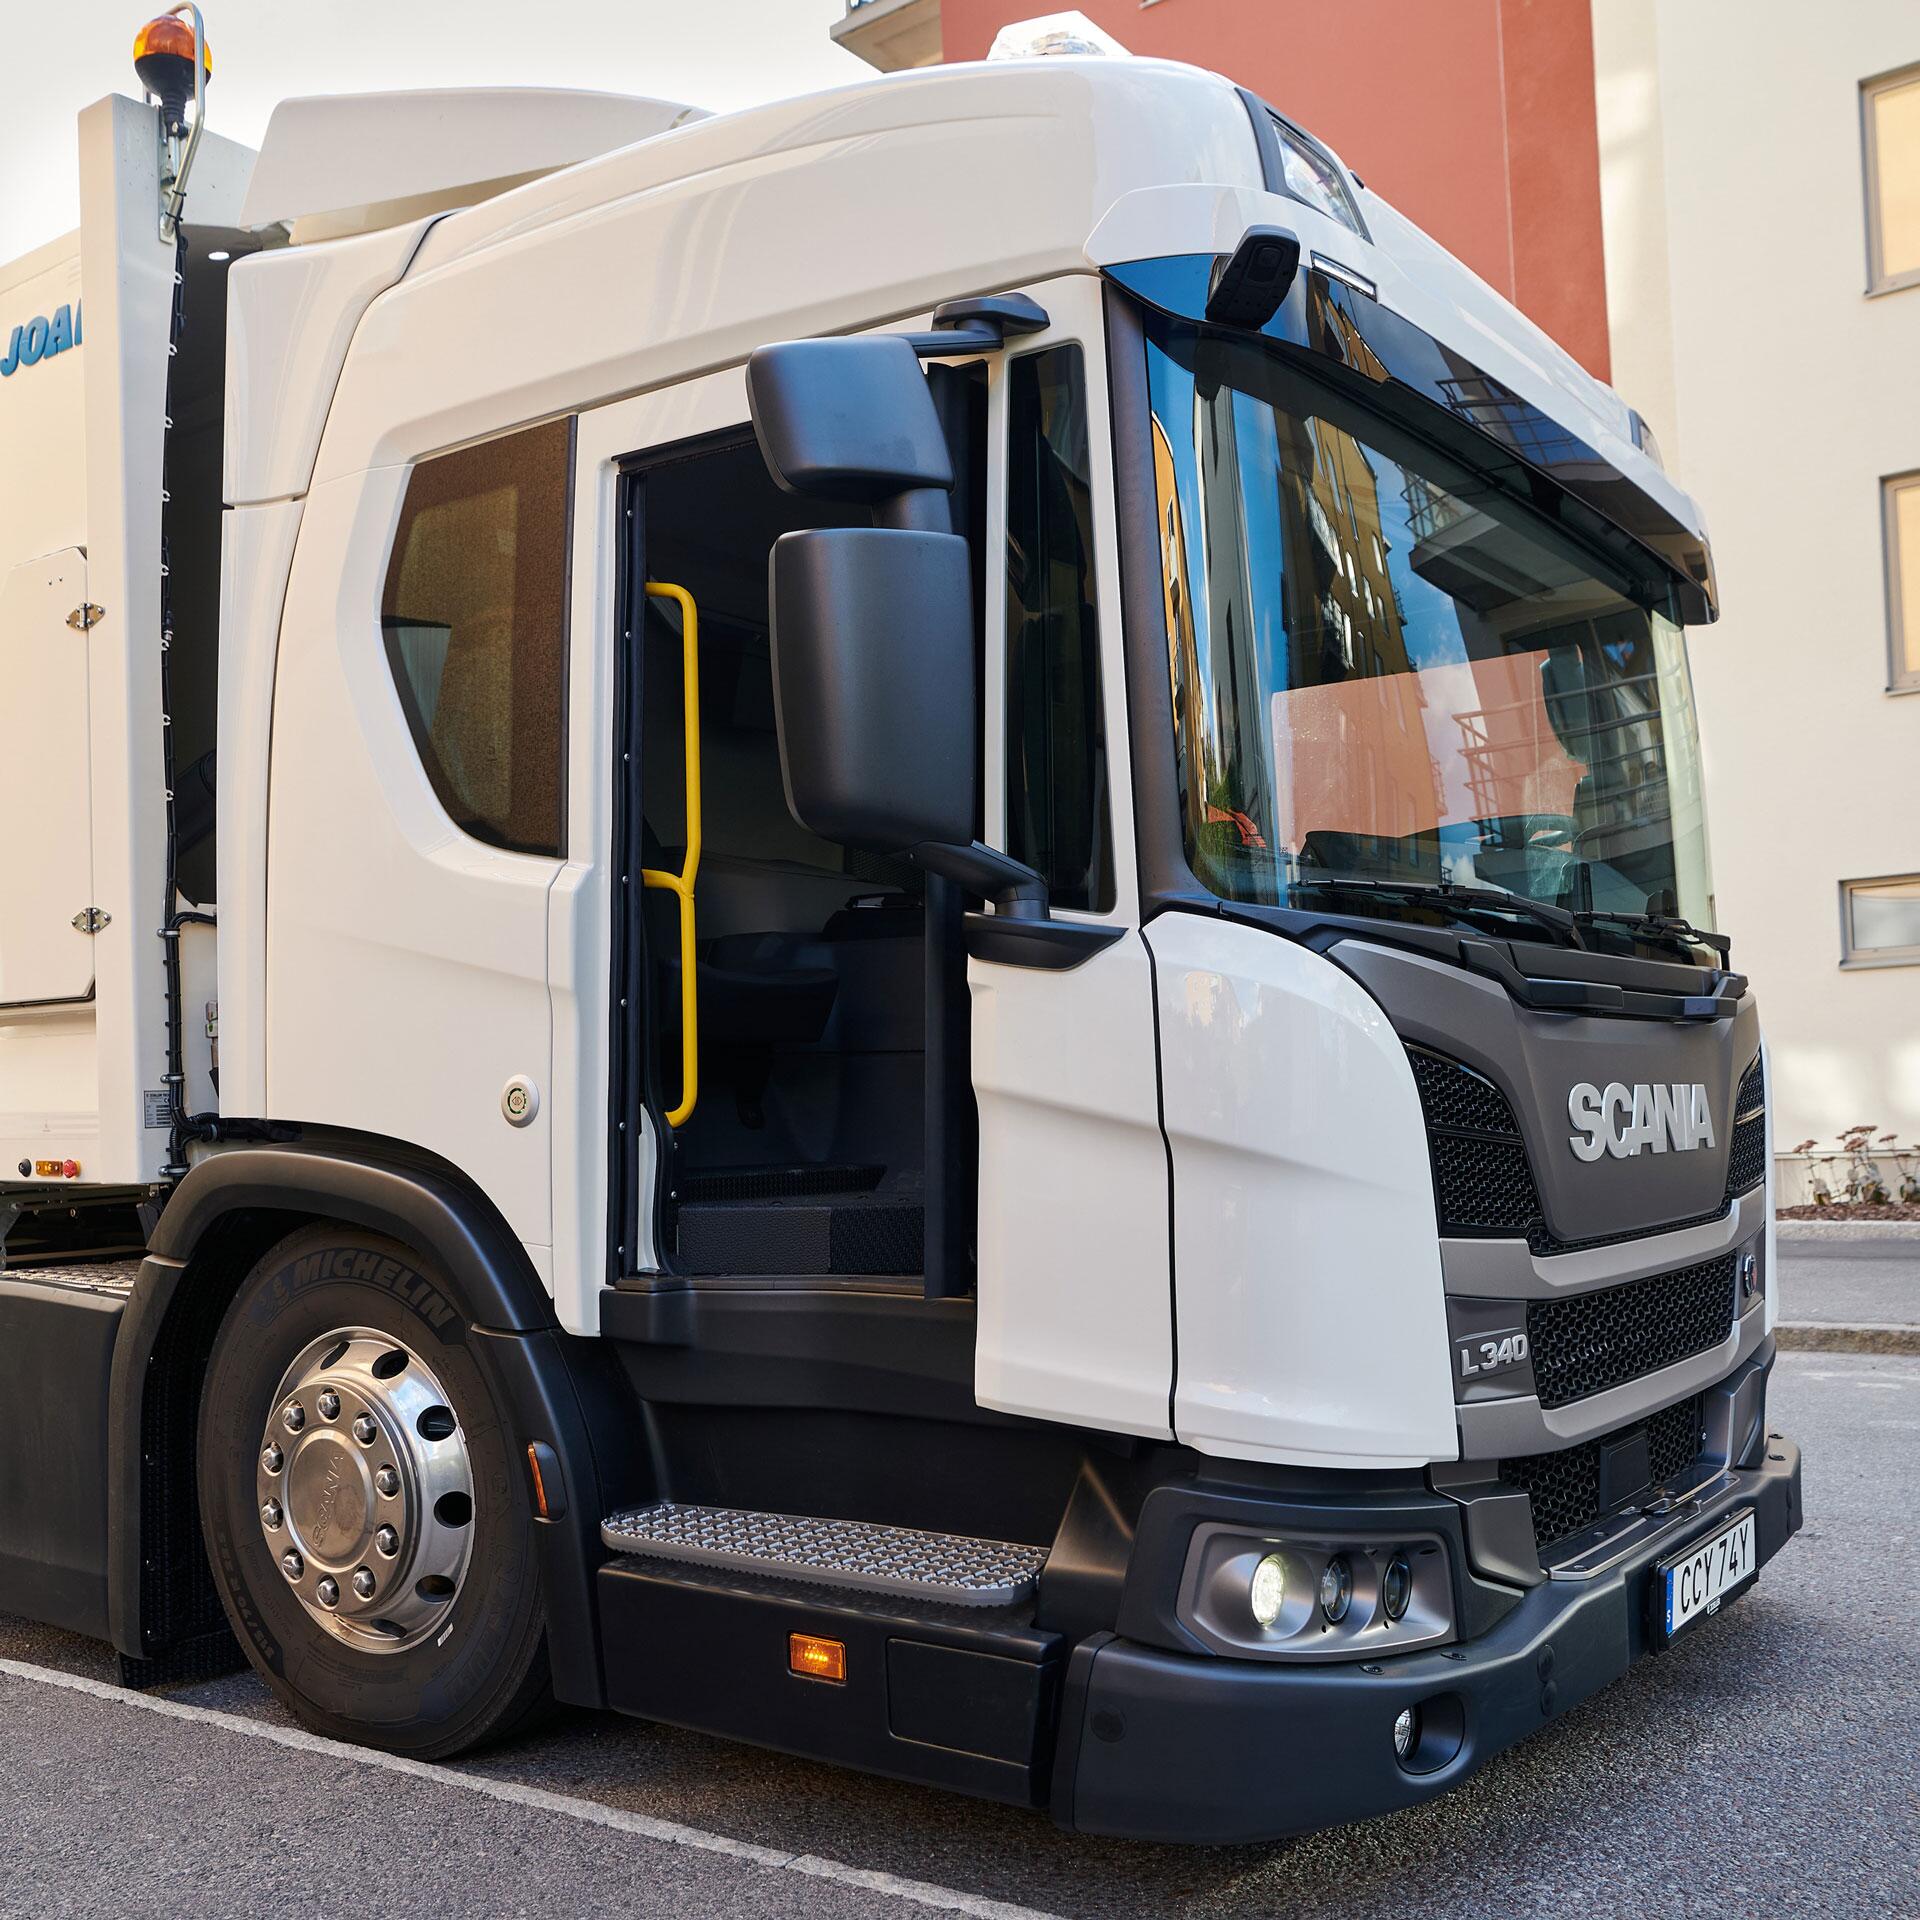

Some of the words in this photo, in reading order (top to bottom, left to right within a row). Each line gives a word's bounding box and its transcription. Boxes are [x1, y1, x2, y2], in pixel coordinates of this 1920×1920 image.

[0, 298, 82, 377] JOA
[1568, 1082, 1716, 1162] SCANIA
[293, 1249, 455, 1328] MICHELIN
[1681, 1547, 1714, 1614] CCY
[1719, 1523, 1748, 1588] 74Y
[1666, 1609, 1671, 1623] S
